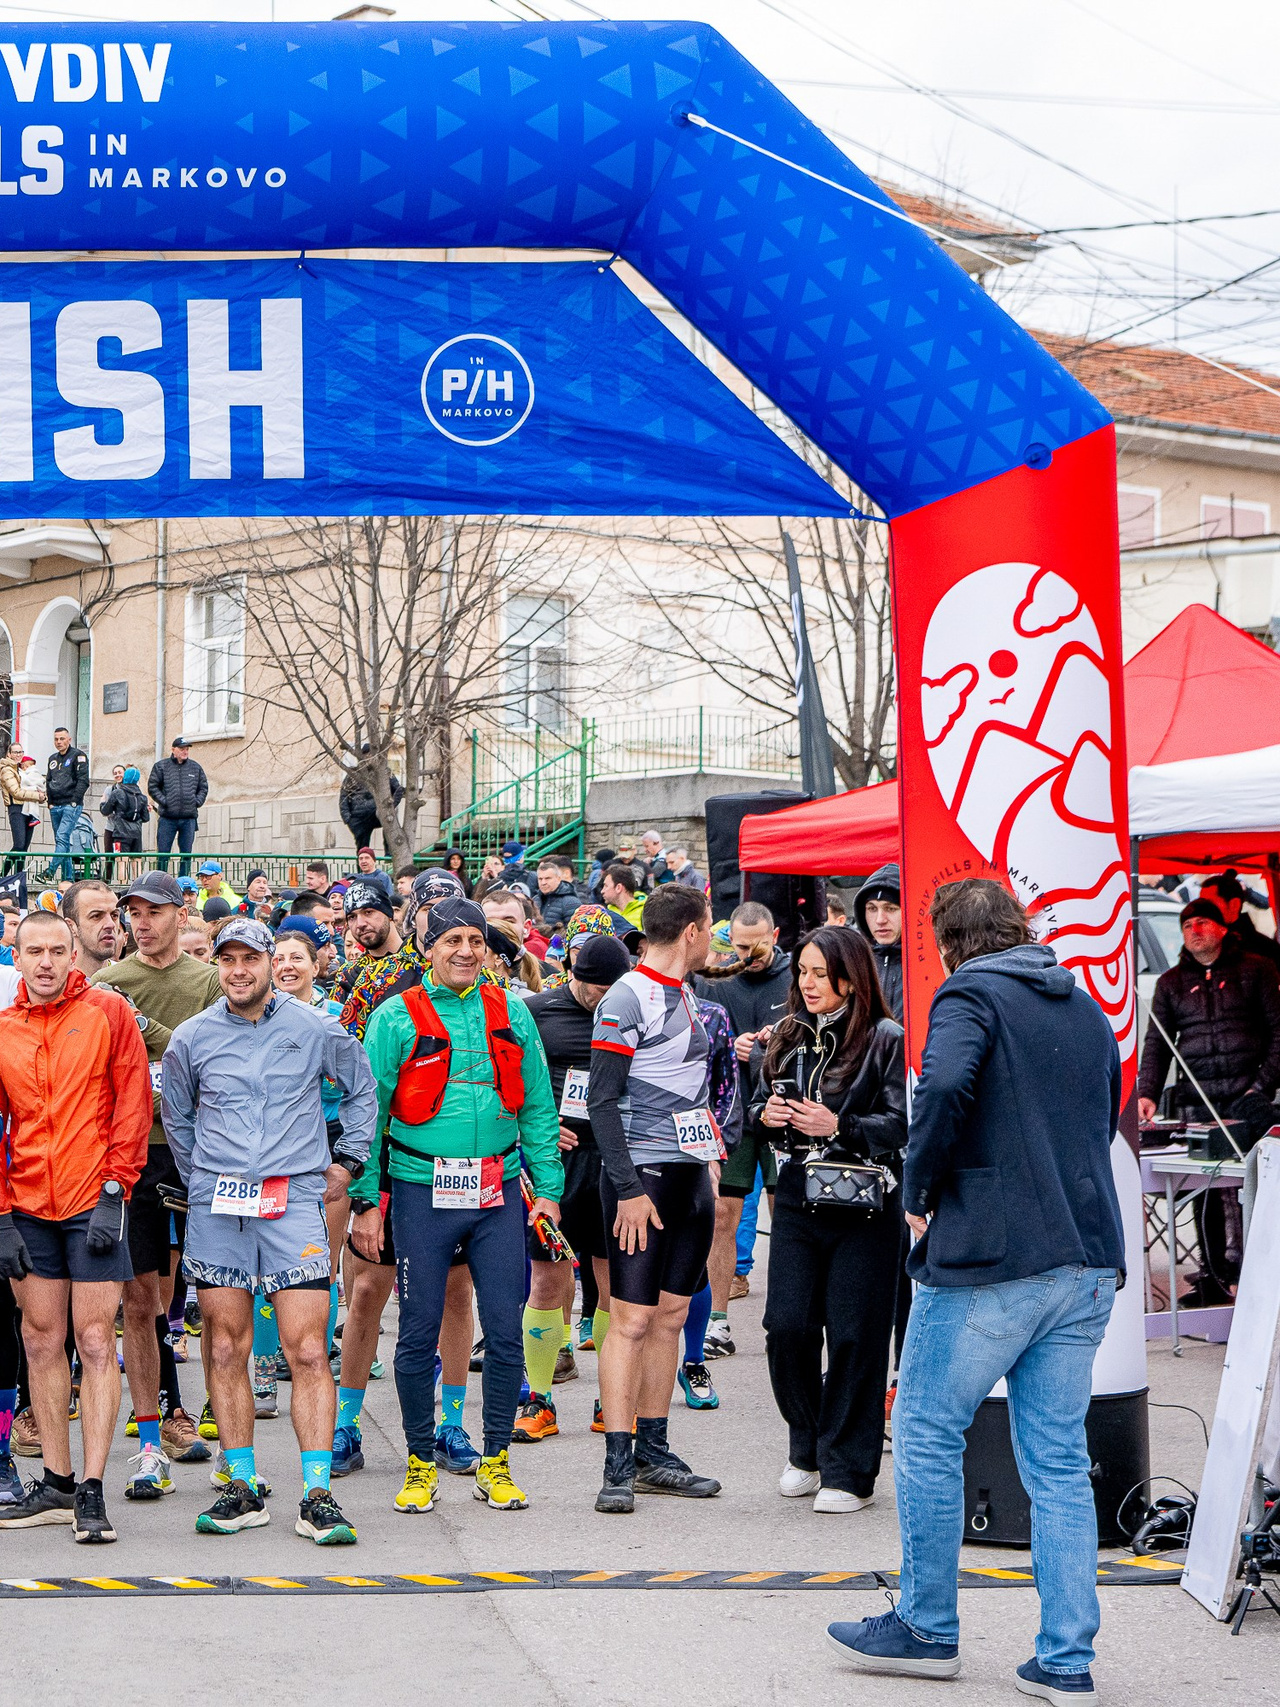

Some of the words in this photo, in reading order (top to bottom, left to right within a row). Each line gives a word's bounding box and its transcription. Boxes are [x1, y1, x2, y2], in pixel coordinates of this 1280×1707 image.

[89, 133, 127, 156] IN
[89, 167, 287, 189] MARKOVO
[469, 356, 484, 365] IN
[442, 369, 514, 405] P/H
[442, 408, 514, 417] MARKOVO
[931, 859, 972, 888] HILLS
[981, 860, 998, 871] IN
[1006, 866, 1059, 937] MARKOVO
[415, 1055, 441, 1067] SALOMON
[534, 1039, 547, 1067] SALOMON
[679, 1124, 713, 1143] 2363
[216, 1181, 259, 1199] 2286
[434, 1175, 478, 1189] ABBAS
